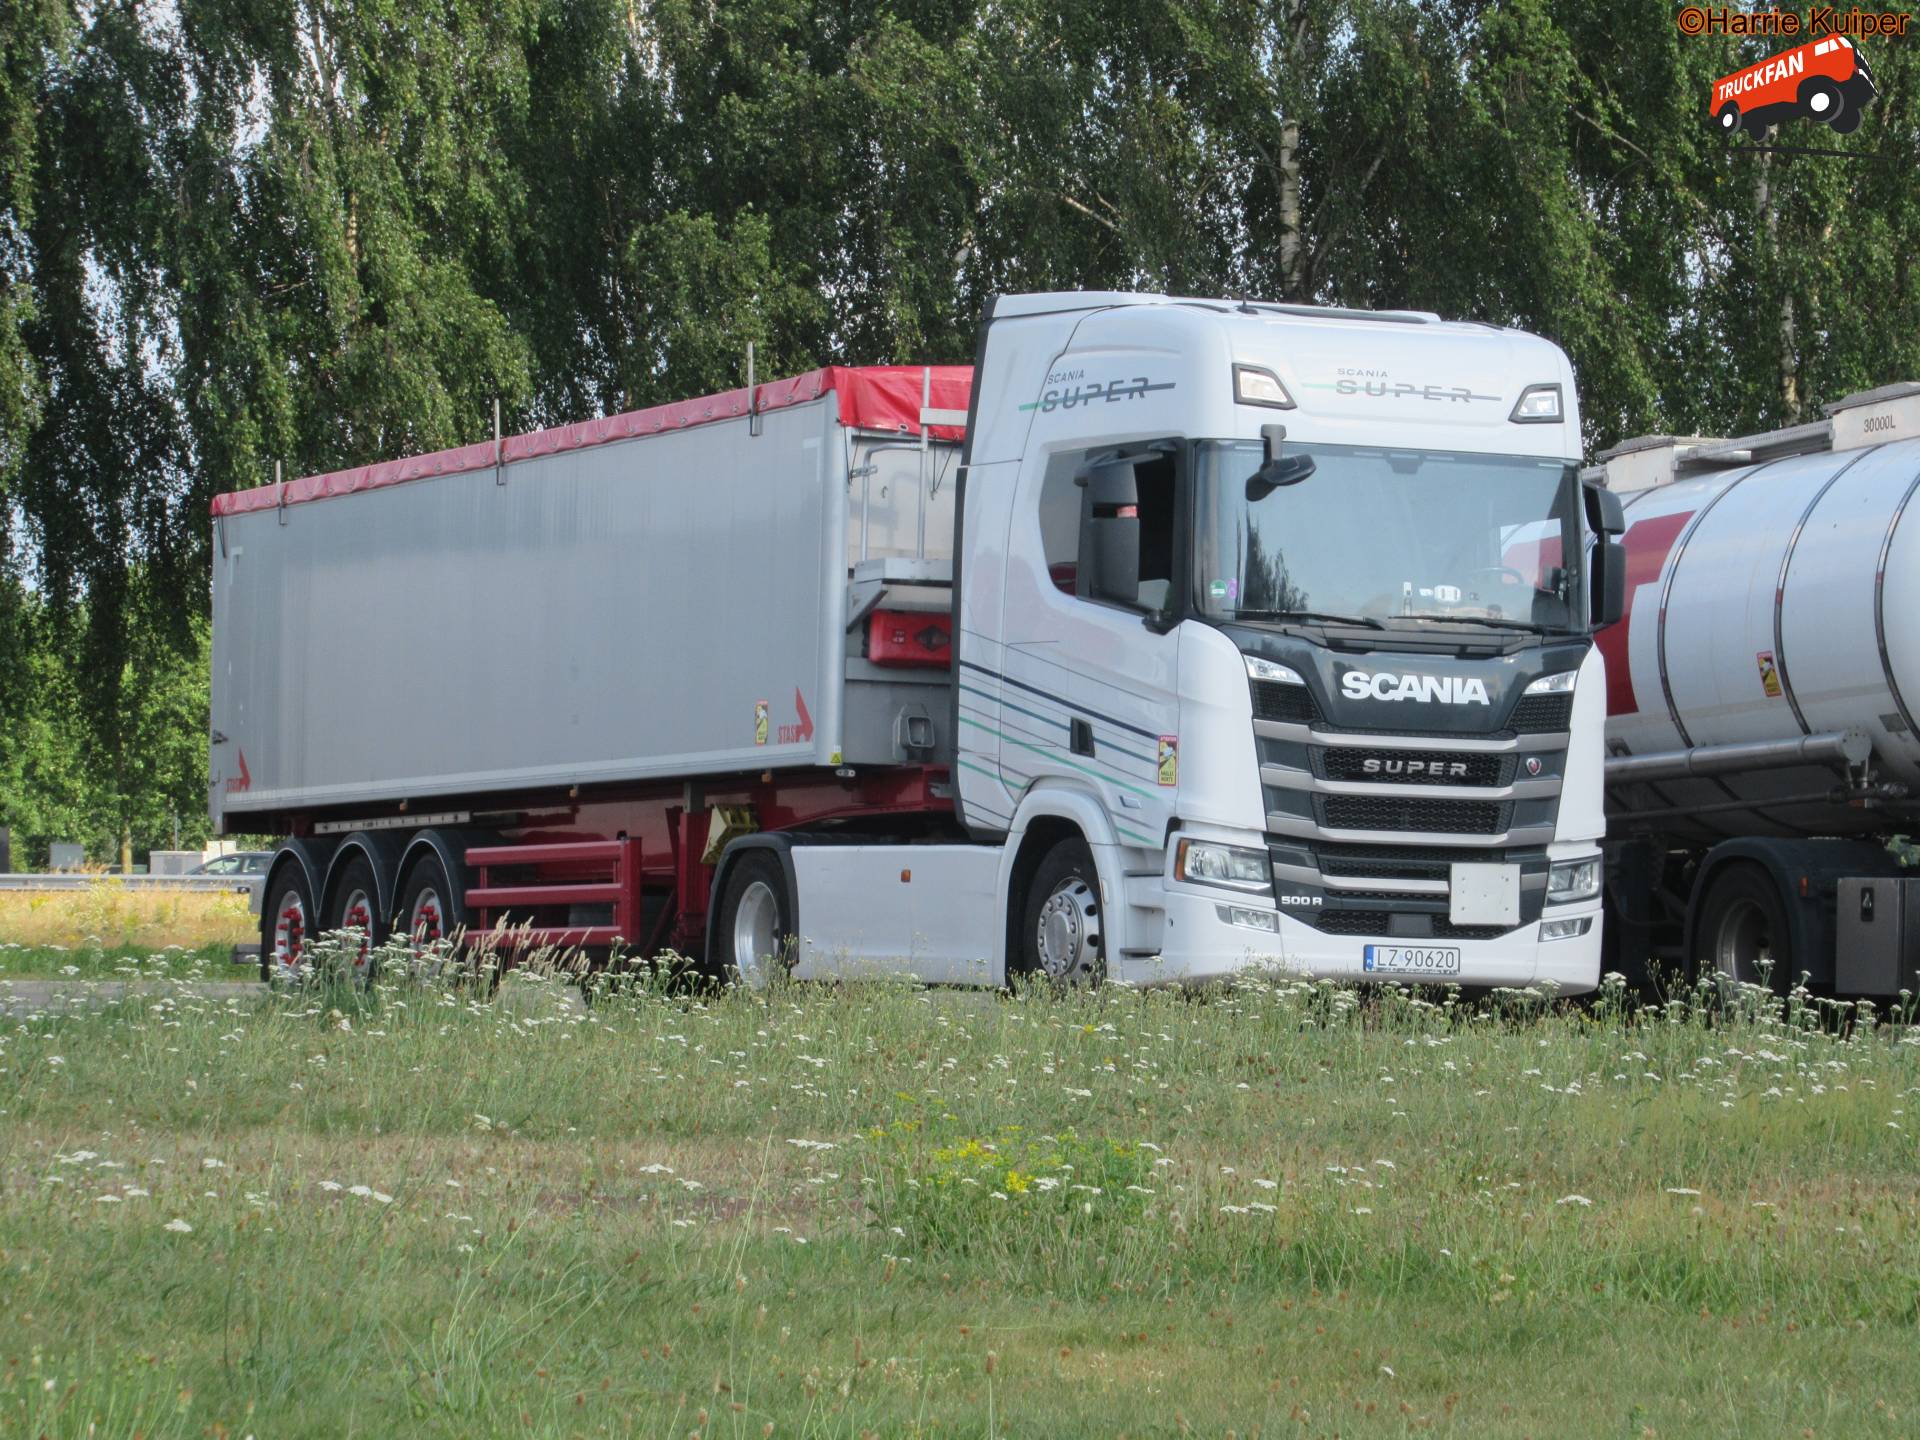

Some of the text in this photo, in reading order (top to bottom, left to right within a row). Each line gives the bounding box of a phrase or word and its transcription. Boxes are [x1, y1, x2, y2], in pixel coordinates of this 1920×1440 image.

[1047, 369, 1085, 385] SCANIA
[1337, 368, 1389, 378] SCANIA
[1042, 376, 1149, 413] SUPER
[1335, 379, 1472, 403] SUPER
[1863, 414, 1896, 433] 30000L
[1341, 671, 1490, 706] SCANIA
[1362, 759, 1468, 776] SUPER
[1404, 950, 1455, 969] 90620
